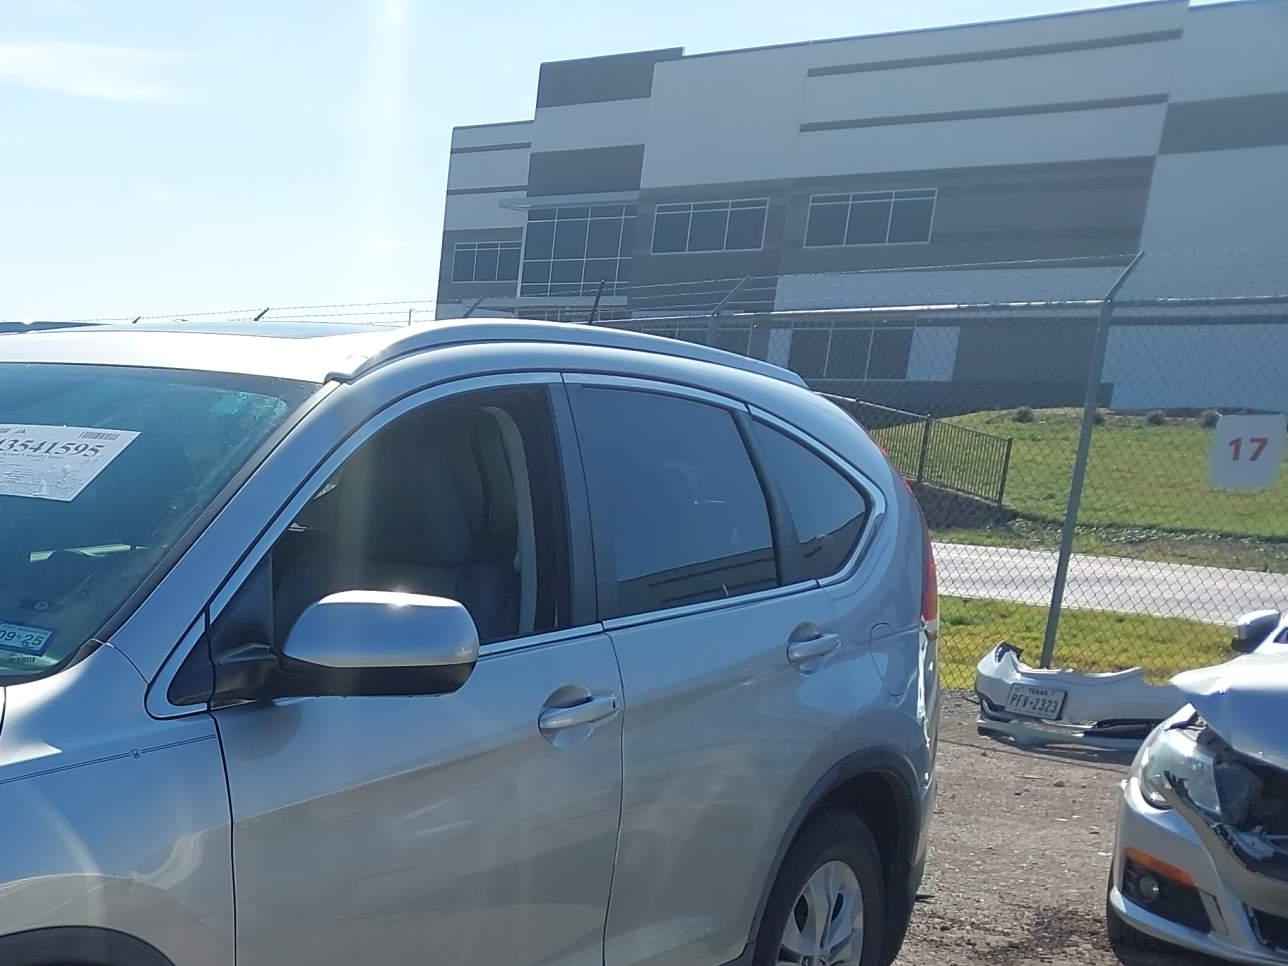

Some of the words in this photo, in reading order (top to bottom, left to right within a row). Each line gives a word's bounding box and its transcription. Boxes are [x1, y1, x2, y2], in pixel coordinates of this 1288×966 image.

[1228, 437, 1269, 461] 17
[22, 633, 45, 646] 25
[1028, 687, 1049, 696] TEXAS
